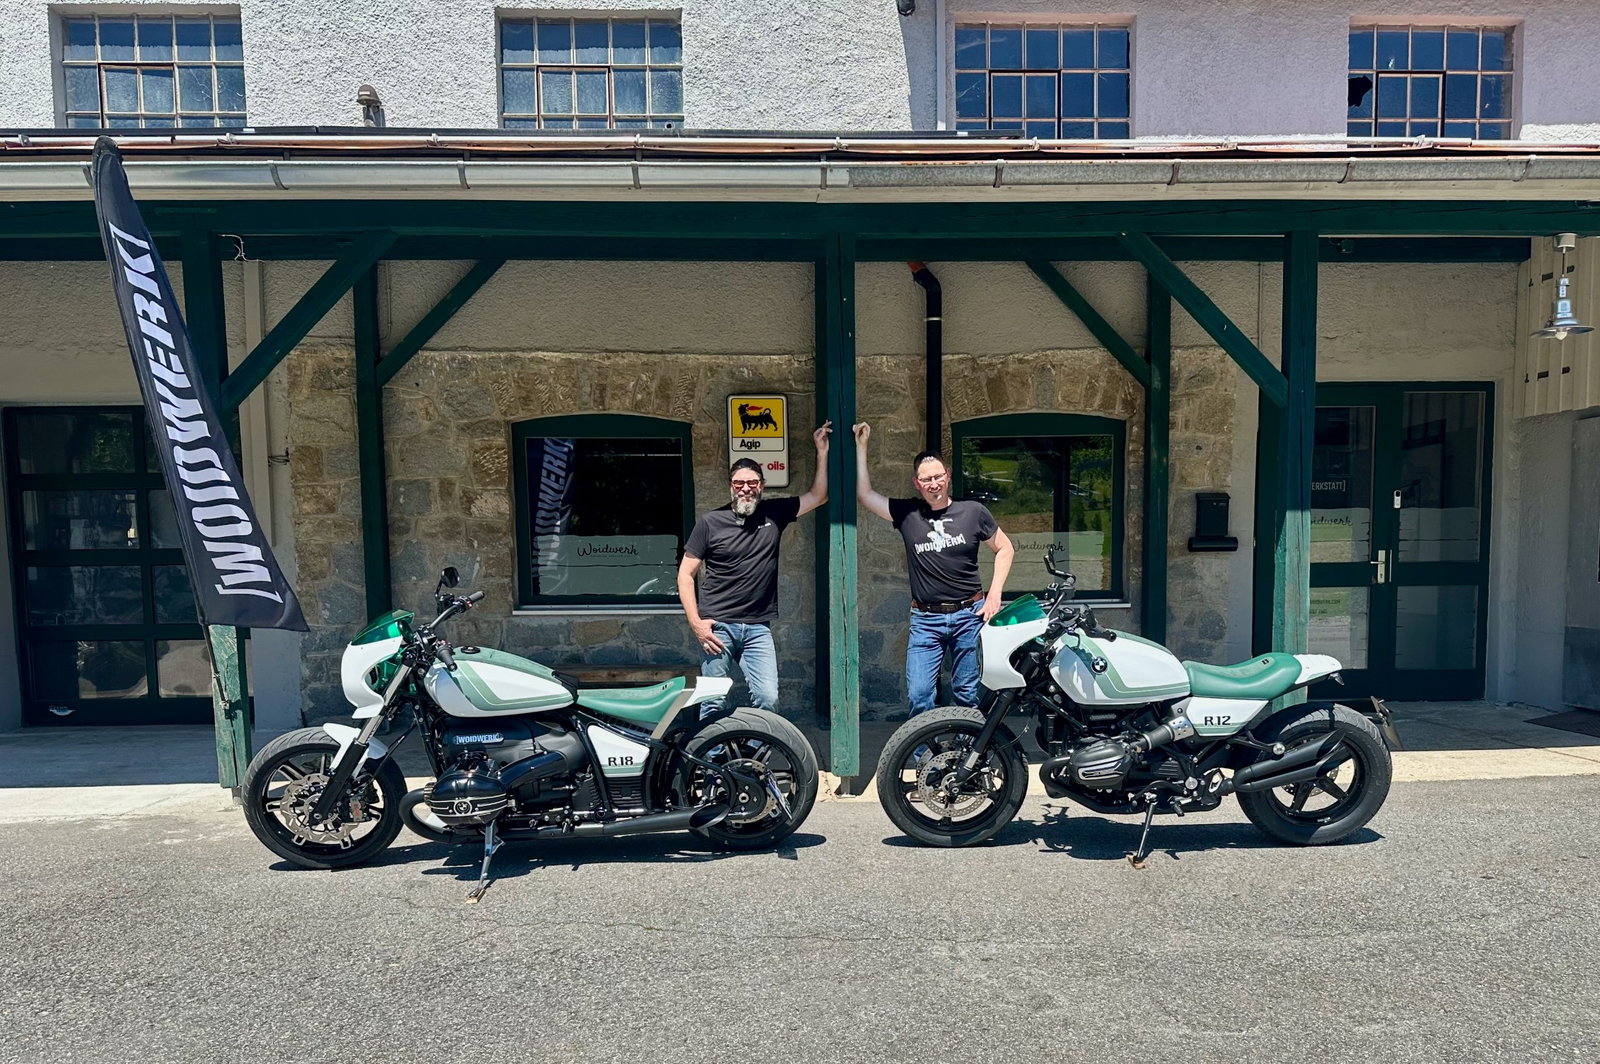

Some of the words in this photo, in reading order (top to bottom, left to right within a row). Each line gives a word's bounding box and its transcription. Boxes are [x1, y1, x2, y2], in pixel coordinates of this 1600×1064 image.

[739, 438, 761, 450] Agip
[767, 461, 785, 471] oils
[1311, 480, 1346, 492] ERKSTATT]
[577, 543, 639, 557] Woidwerk
